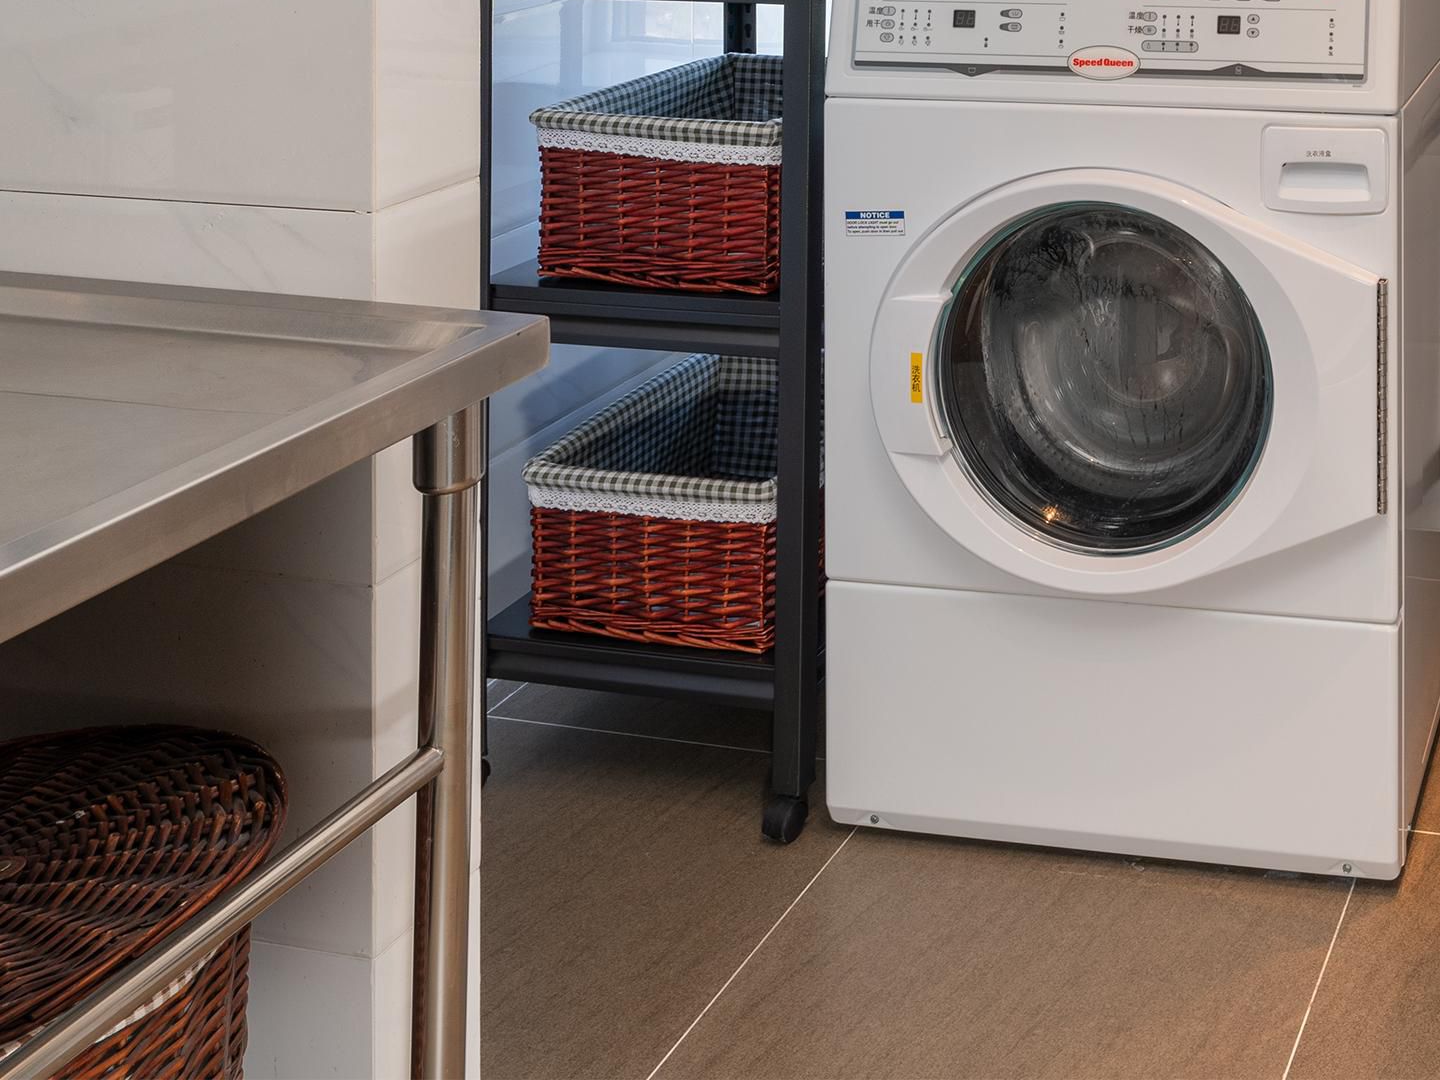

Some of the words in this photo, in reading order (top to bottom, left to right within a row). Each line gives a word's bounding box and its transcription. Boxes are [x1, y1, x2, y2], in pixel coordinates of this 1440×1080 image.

[1073, 58, 1103, 67] Speed
[1103, 58, 1134, 67] Queen
[912, 365, 921, 393] 洗衣机
